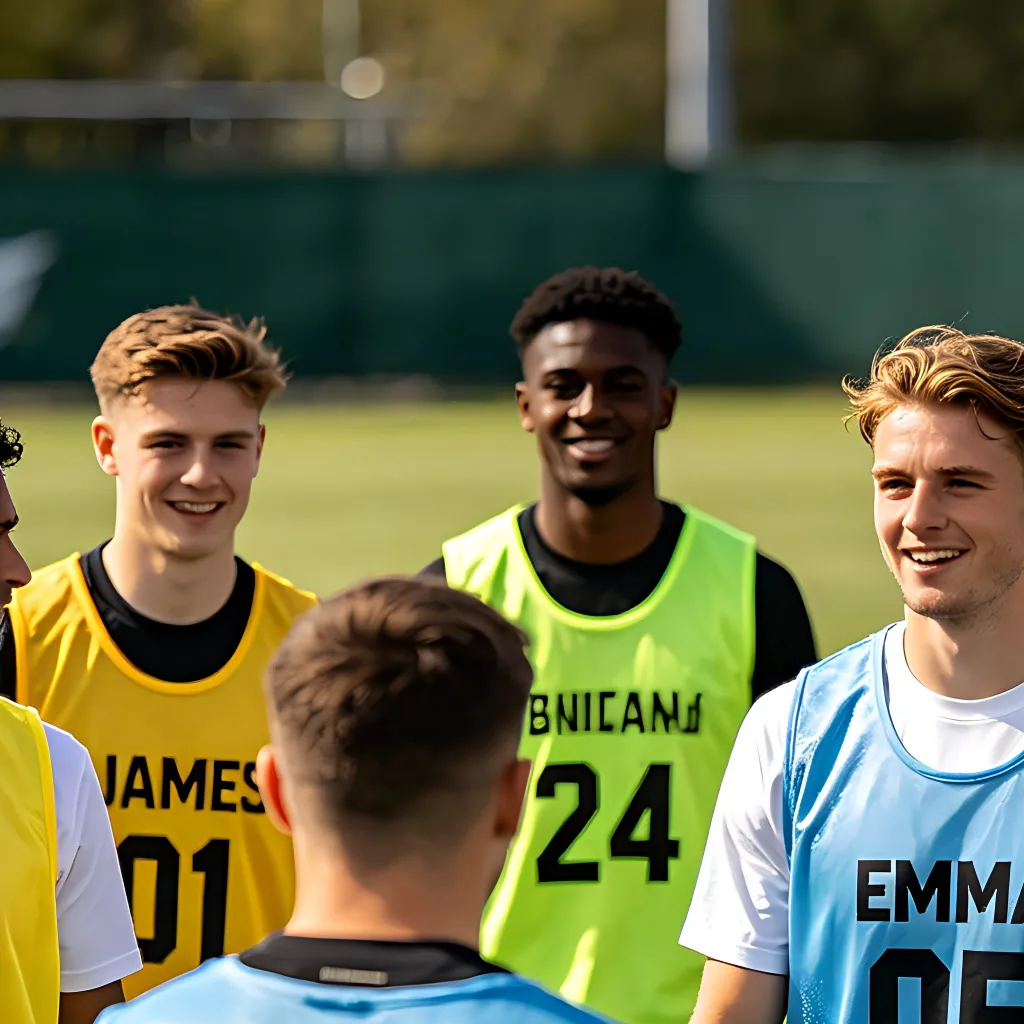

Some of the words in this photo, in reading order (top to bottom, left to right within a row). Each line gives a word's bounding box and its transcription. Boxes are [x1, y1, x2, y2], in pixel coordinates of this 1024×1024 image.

[104, 755, 265, 814] JAMES
[536, 763, 680, 882] 24
[117, 834, 230, 966] 01
